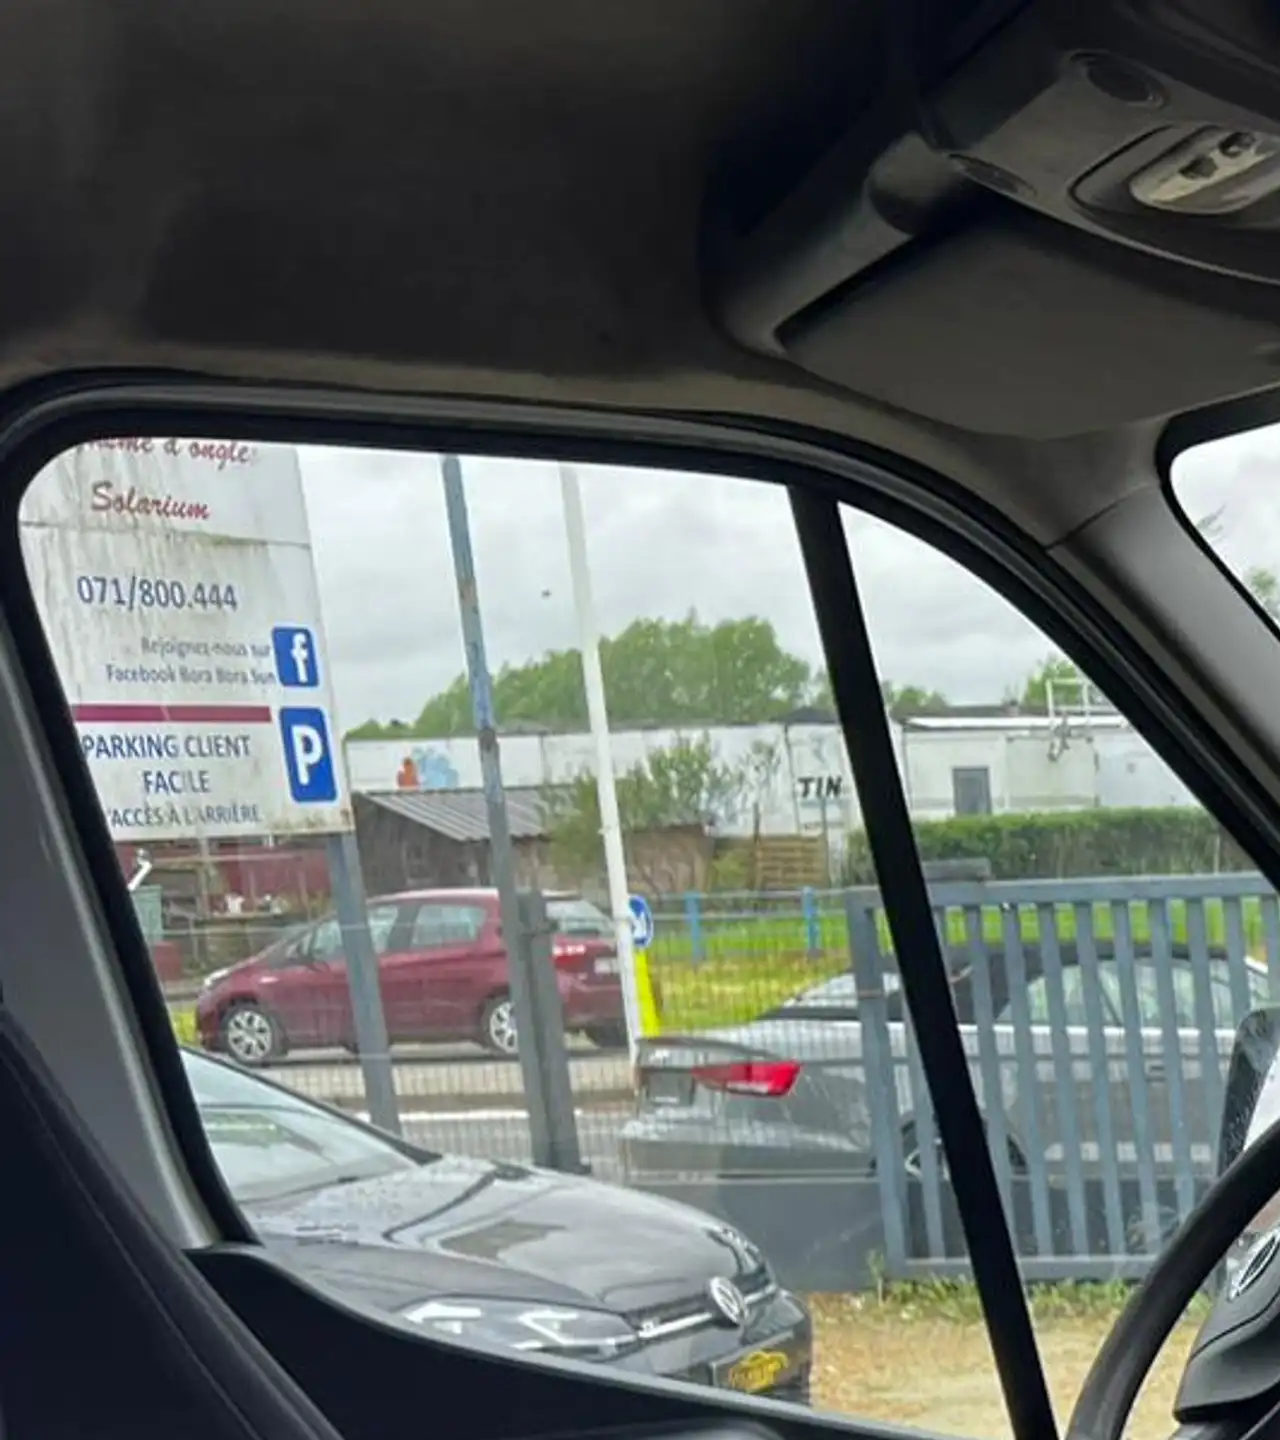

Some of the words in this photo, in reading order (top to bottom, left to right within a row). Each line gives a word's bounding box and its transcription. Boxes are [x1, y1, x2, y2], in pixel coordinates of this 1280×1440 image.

[91, 480, 210, 520] Solarium
[77, 574, 238, 612] 071/800.444
[106, 663, 175, 683] Facebook
[82, 733, 179, 760] PARKING
[184, 734, 251, 759] CLIENT
[290, 724, 323, 786] P
[142, 770, 211, 794] FACILE
[798, 775, 842, 798] TIN
